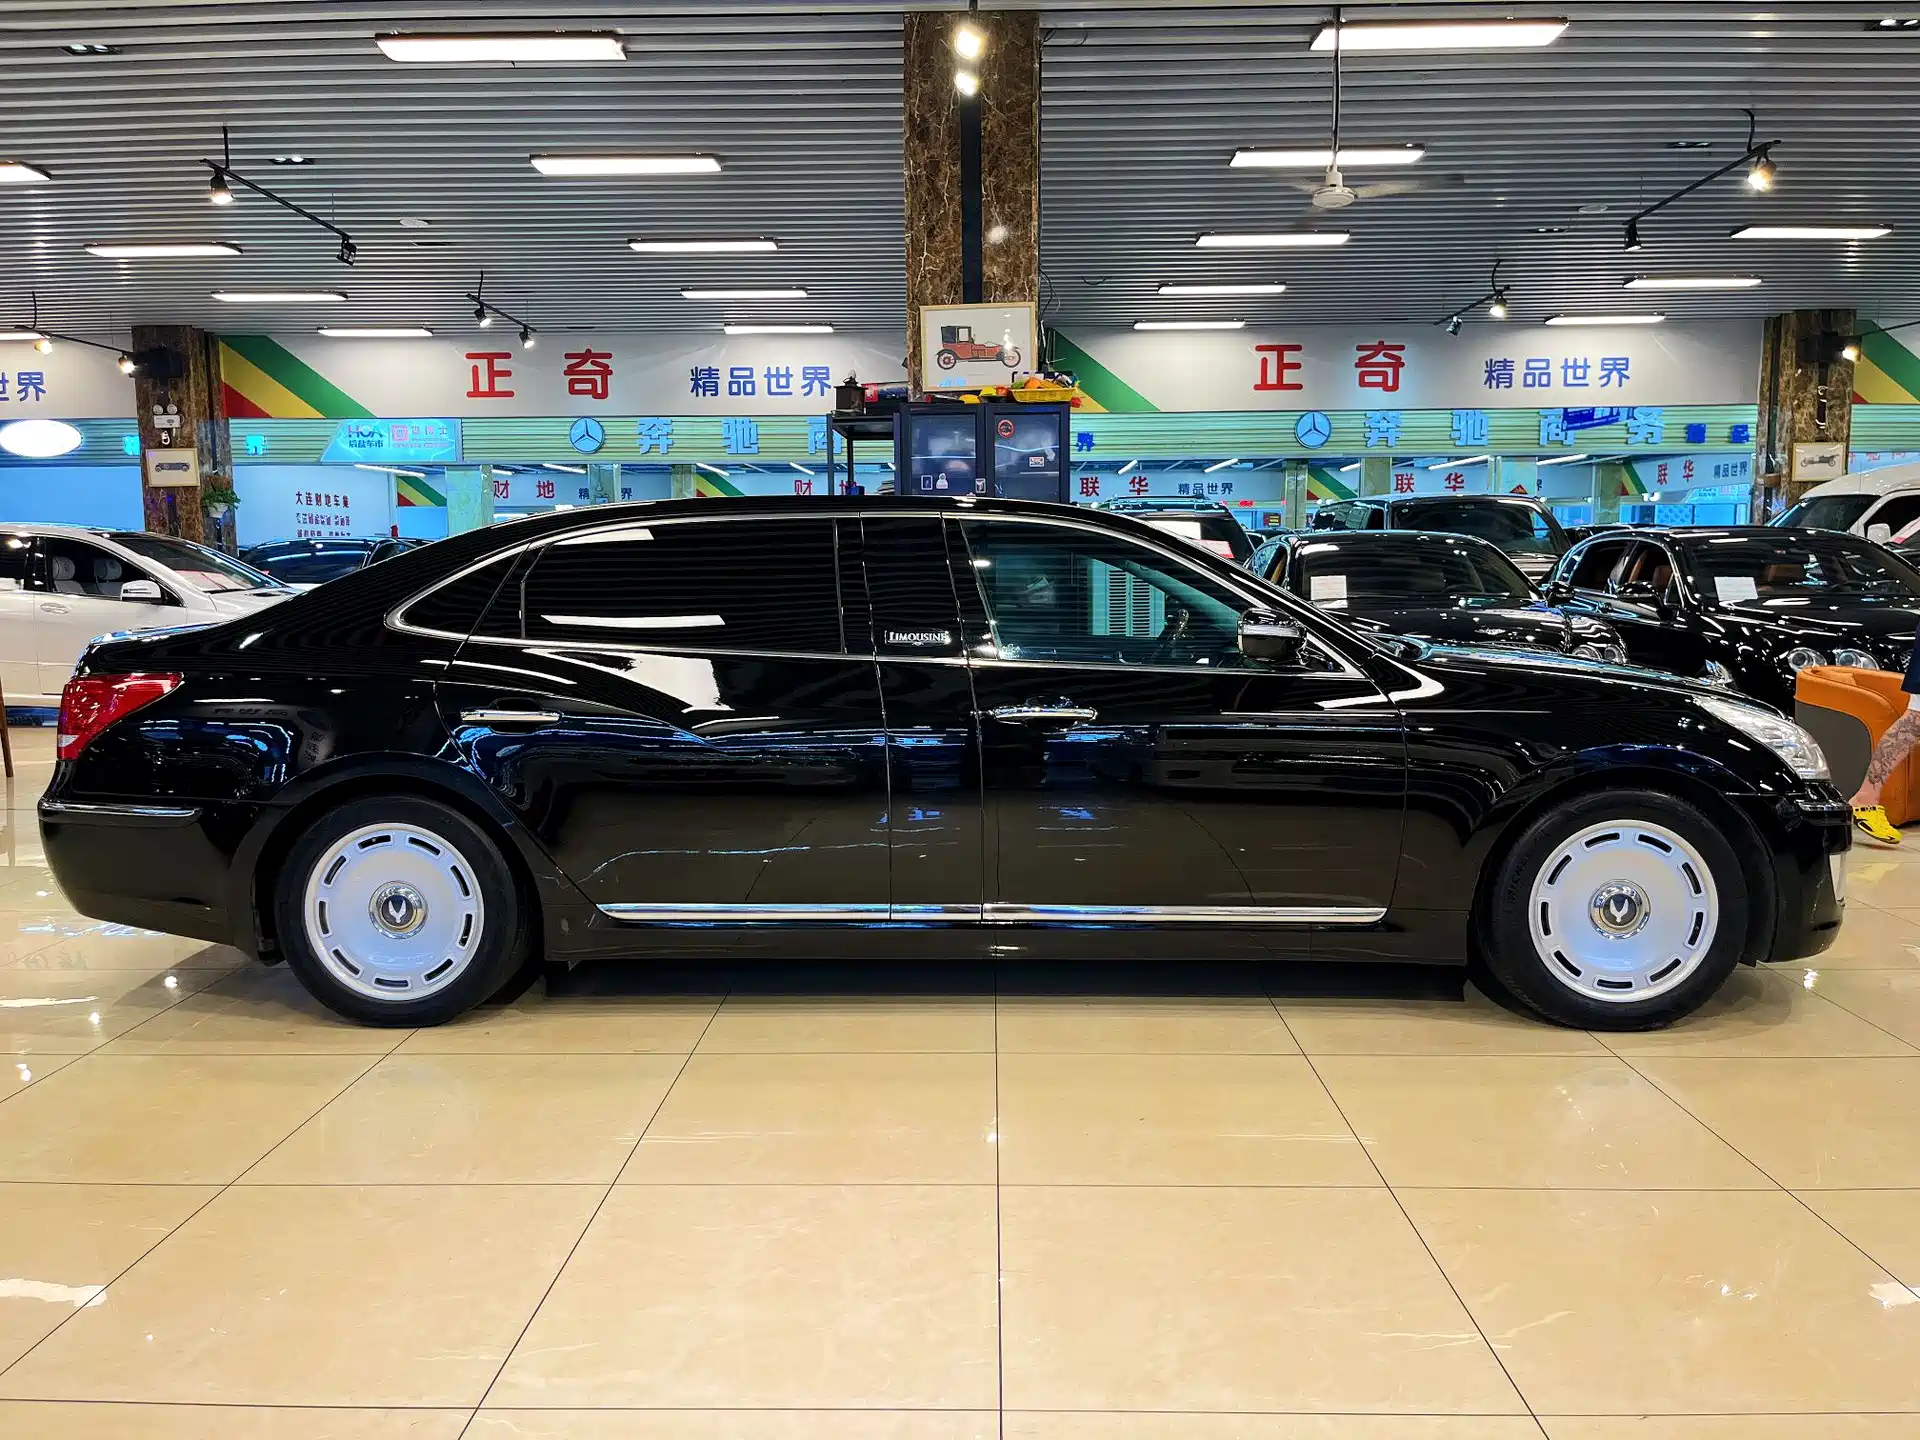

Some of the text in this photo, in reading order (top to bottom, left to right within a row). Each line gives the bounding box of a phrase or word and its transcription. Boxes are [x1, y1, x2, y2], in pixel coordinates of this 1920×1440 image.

[466, 349, 832, 400] 正奇 精品世界
[1253, 341, 1631, 393] 正奇 精品世界
[1079, 476, 1234, 497] 联华 精品世界
[1394, 472, 1465, 493] 联华
